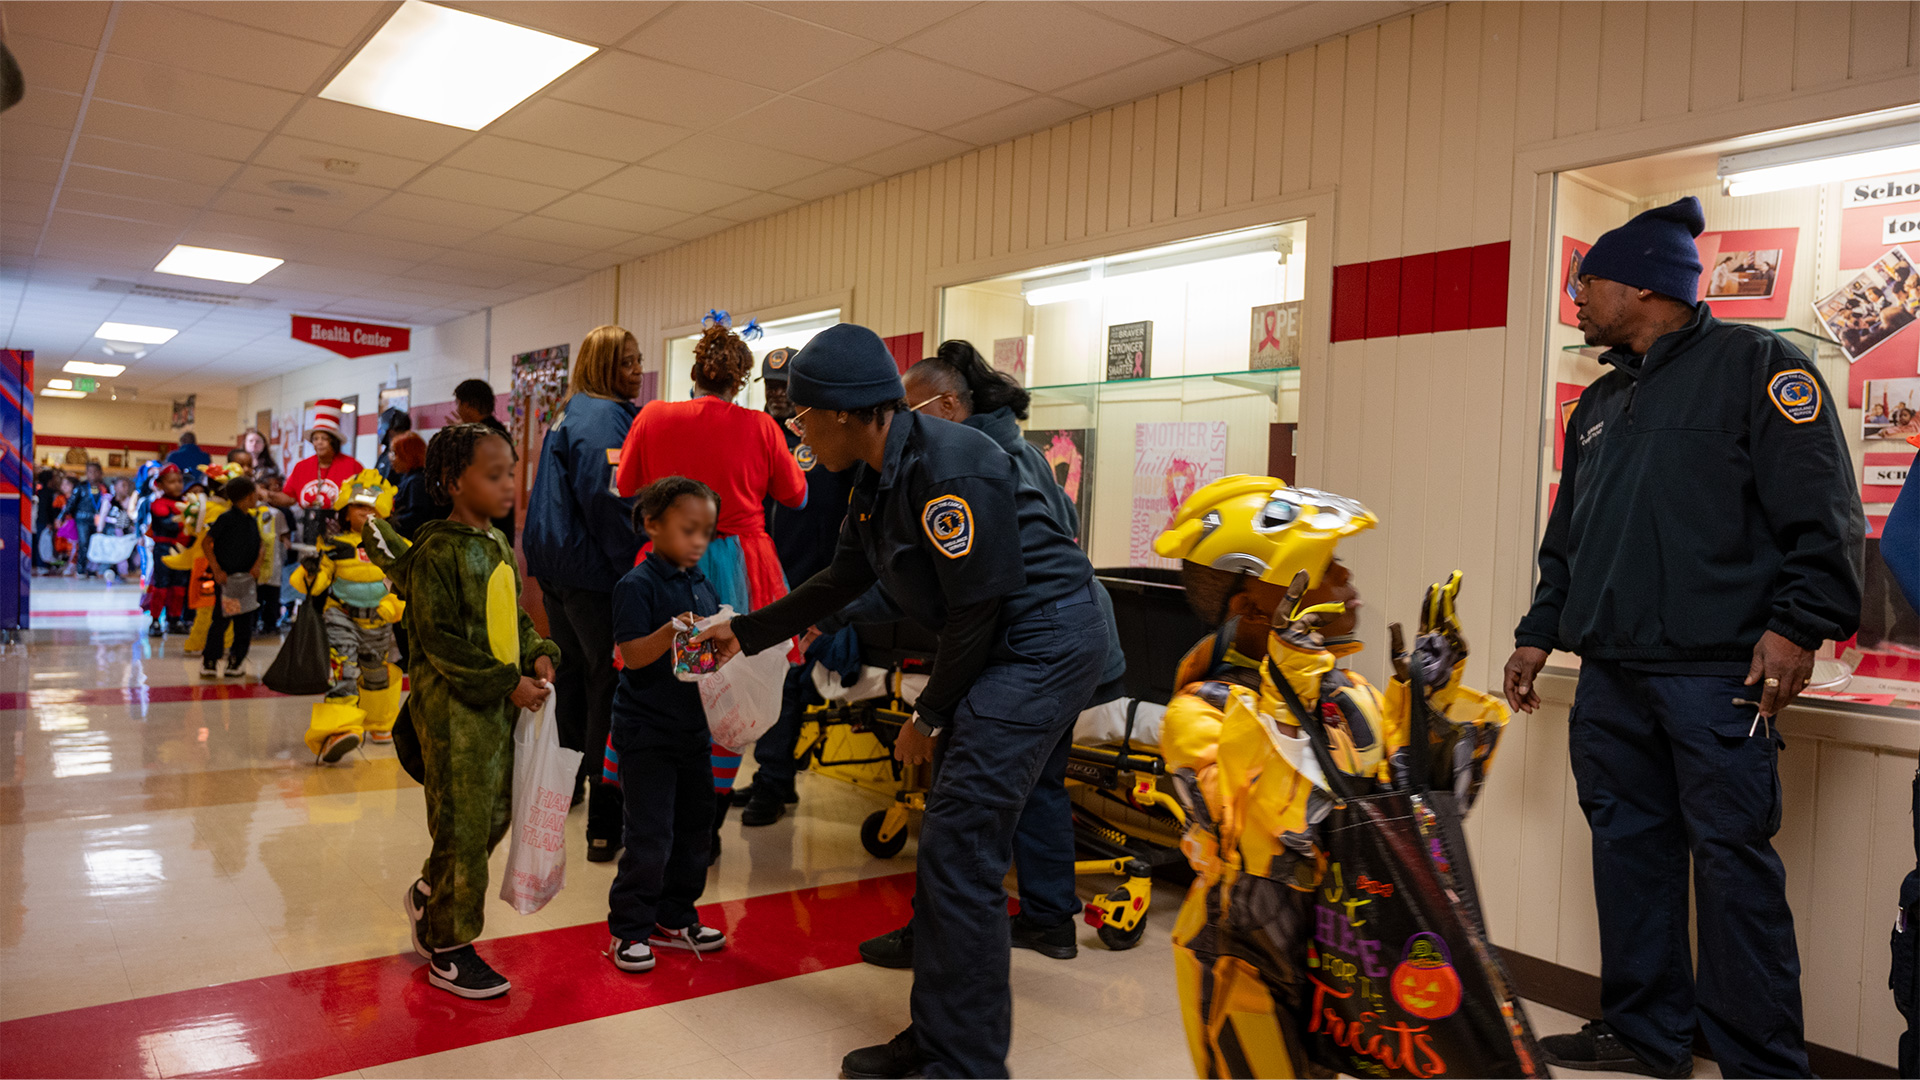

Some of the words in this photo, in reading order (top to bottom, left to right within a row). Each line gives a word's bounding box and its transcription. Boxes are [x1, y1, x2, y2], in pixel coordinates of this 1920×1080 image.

[1889, 219, 1920, 234] to
[311, 323, 350, 343] Health
[353, 328, 392, 348] Center
[1118, 328, 1145, 339] BRAVER
[1109, 341, 1144, 355] STRONGER
[1108, 364, 1133, 376] SMARTER
[1145, 422, 1208, 447] MOTHER
[1210, 421, 1225, 481] SISTE
[1130, 509, 1141, 567] MOTHE
[1139, 512, 1150, 568] GRAN
[522, 825, 565, 853] THAN
[1306, 972, 1447, 1079] Treats
